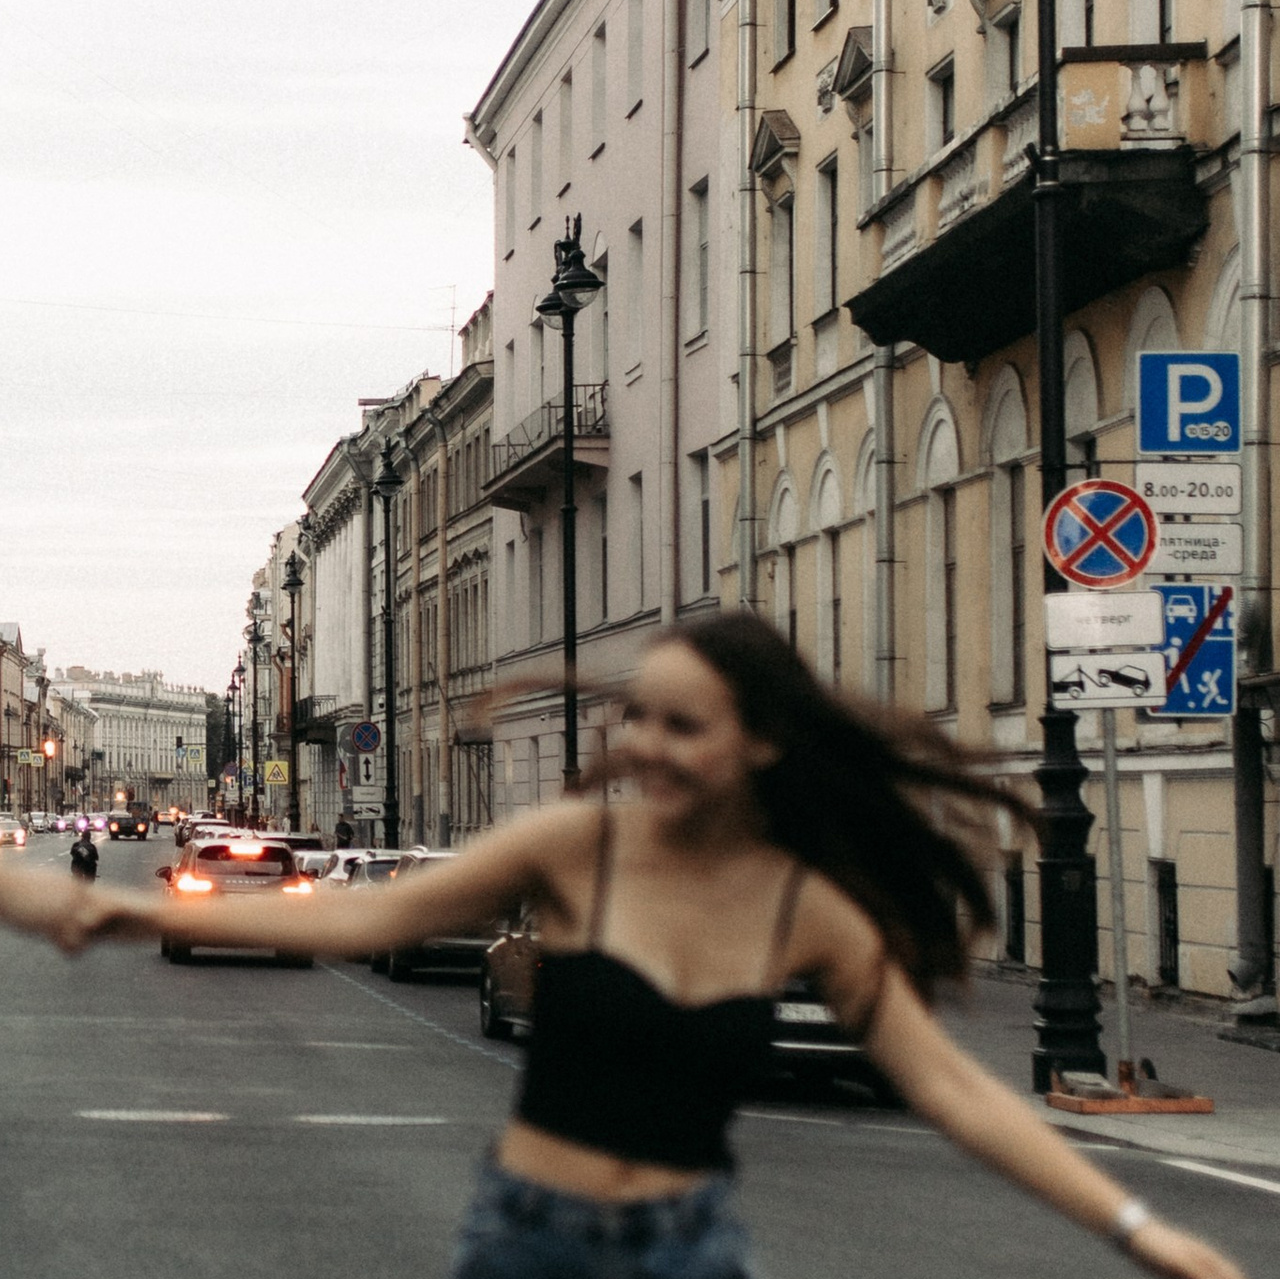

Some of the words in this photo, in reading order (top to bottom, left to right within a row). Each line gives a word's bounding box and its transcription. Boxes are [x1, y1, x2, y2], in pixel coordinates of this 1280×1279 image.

[1167, 363, 1223, 441] P
[1200, 426, 1211, 436] 15
[1213, 425, 1230, 437] 20
[1144, 482, 1234, 498] 8.00-20.00
